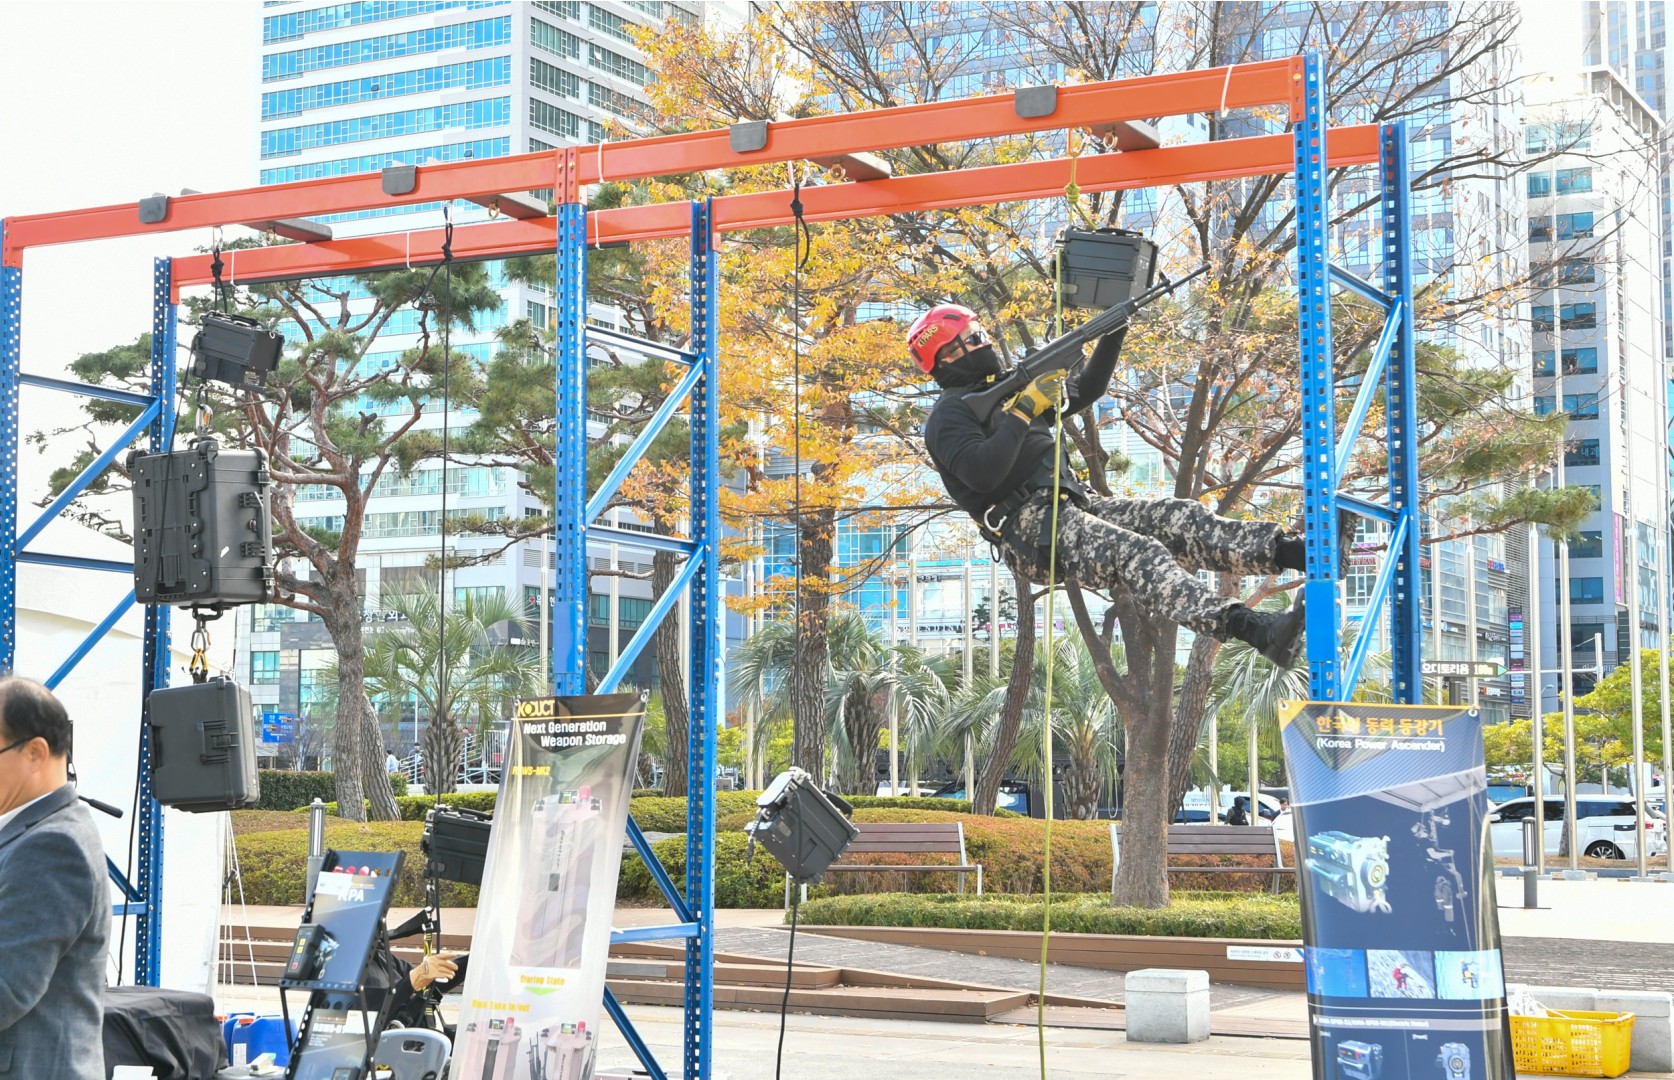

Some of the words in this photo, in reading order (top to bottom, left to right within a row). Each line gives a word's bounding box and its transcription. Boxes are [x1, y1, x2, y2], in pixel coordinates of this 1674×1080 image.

[524, 722, 546, 734] Next
[548, 720, 606, 733] Generation
[1366, 717, 1394, 735] 동력
[1399, 718, 1443, 736] 등강기
[541, 735, 582, 747] Weapon
[585, 734, 626, 745] Storage
[1316, 737, 1352, 749] (Korea
[1355, 739, 1387, 750] Power
[1391, 741, 1445, 752] Ascender)
